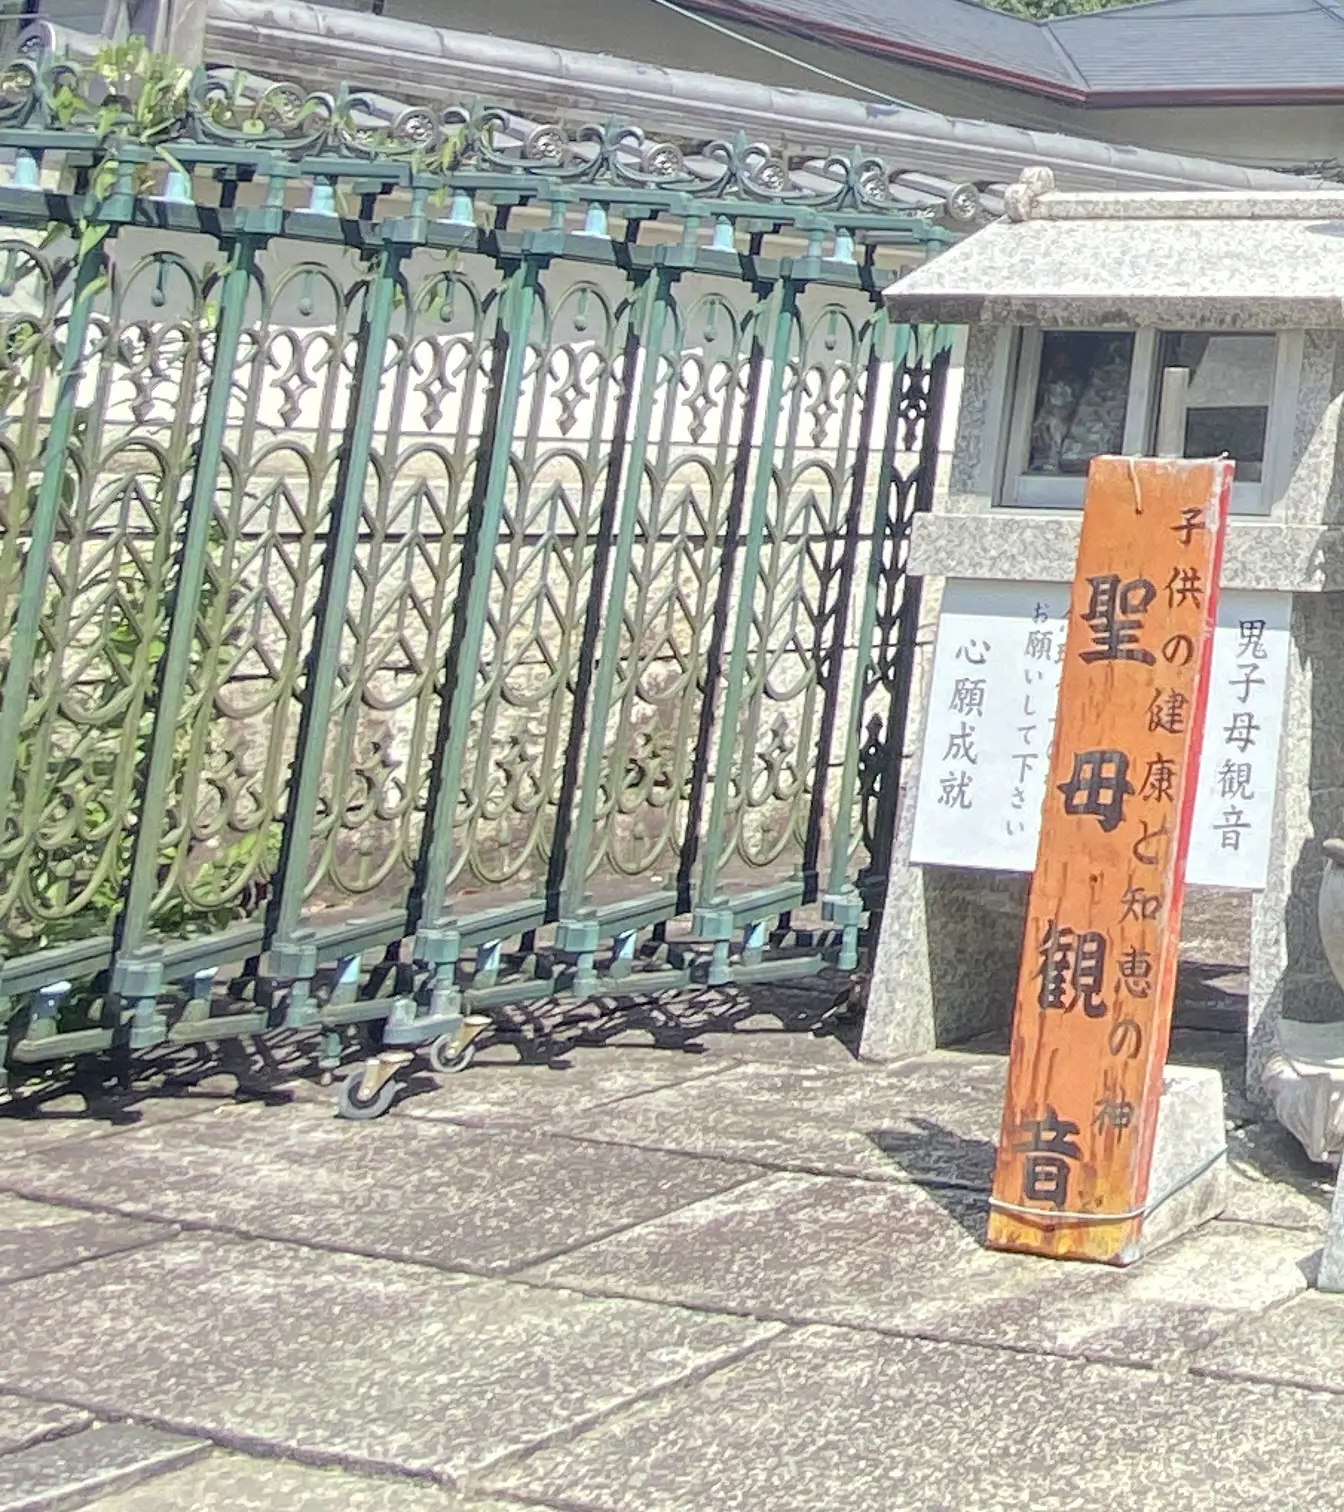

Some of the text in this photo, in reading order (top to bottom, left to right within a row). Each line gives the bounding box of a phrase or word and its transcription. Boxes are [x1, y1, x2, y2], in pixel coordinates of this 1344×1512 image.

[937, 638, 991, 810] 心願成就
[1006, 601, 1053, 836] お願いして下さい
[1012, 573, 1157, 1210] 聖母観音
